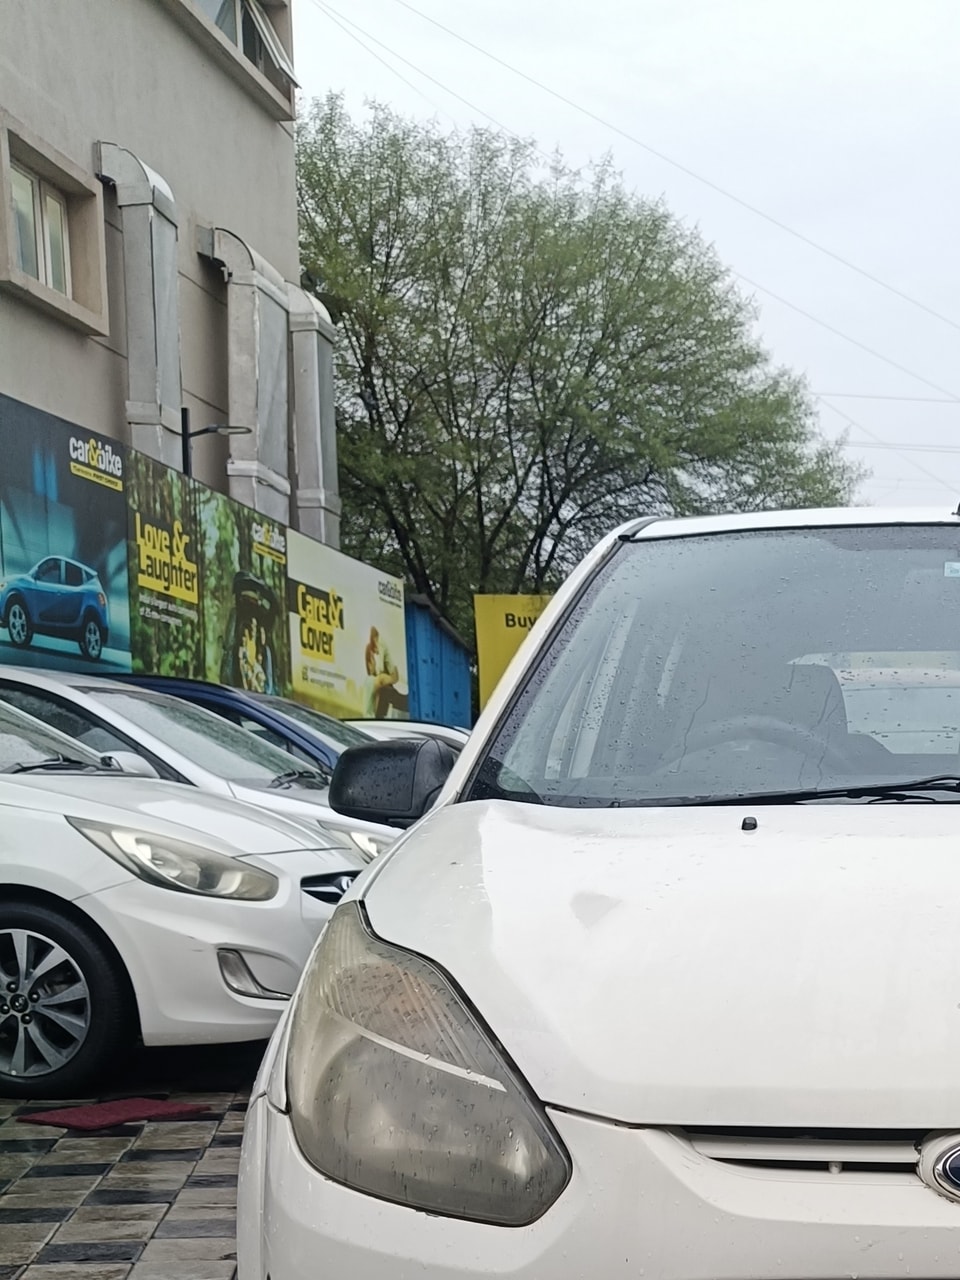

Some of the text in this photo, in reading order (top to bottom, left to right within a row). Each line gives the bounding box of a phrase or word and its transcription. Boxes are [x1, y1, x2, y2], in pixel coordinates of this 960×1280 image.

[69, 437, 122, 477] car&bike
[136, 512, 190, 563] Love &
[140, 547, 196, 592] Laughter
[297, 584, 345, 630] Care &
[300, 617, 334, 656] Cover
